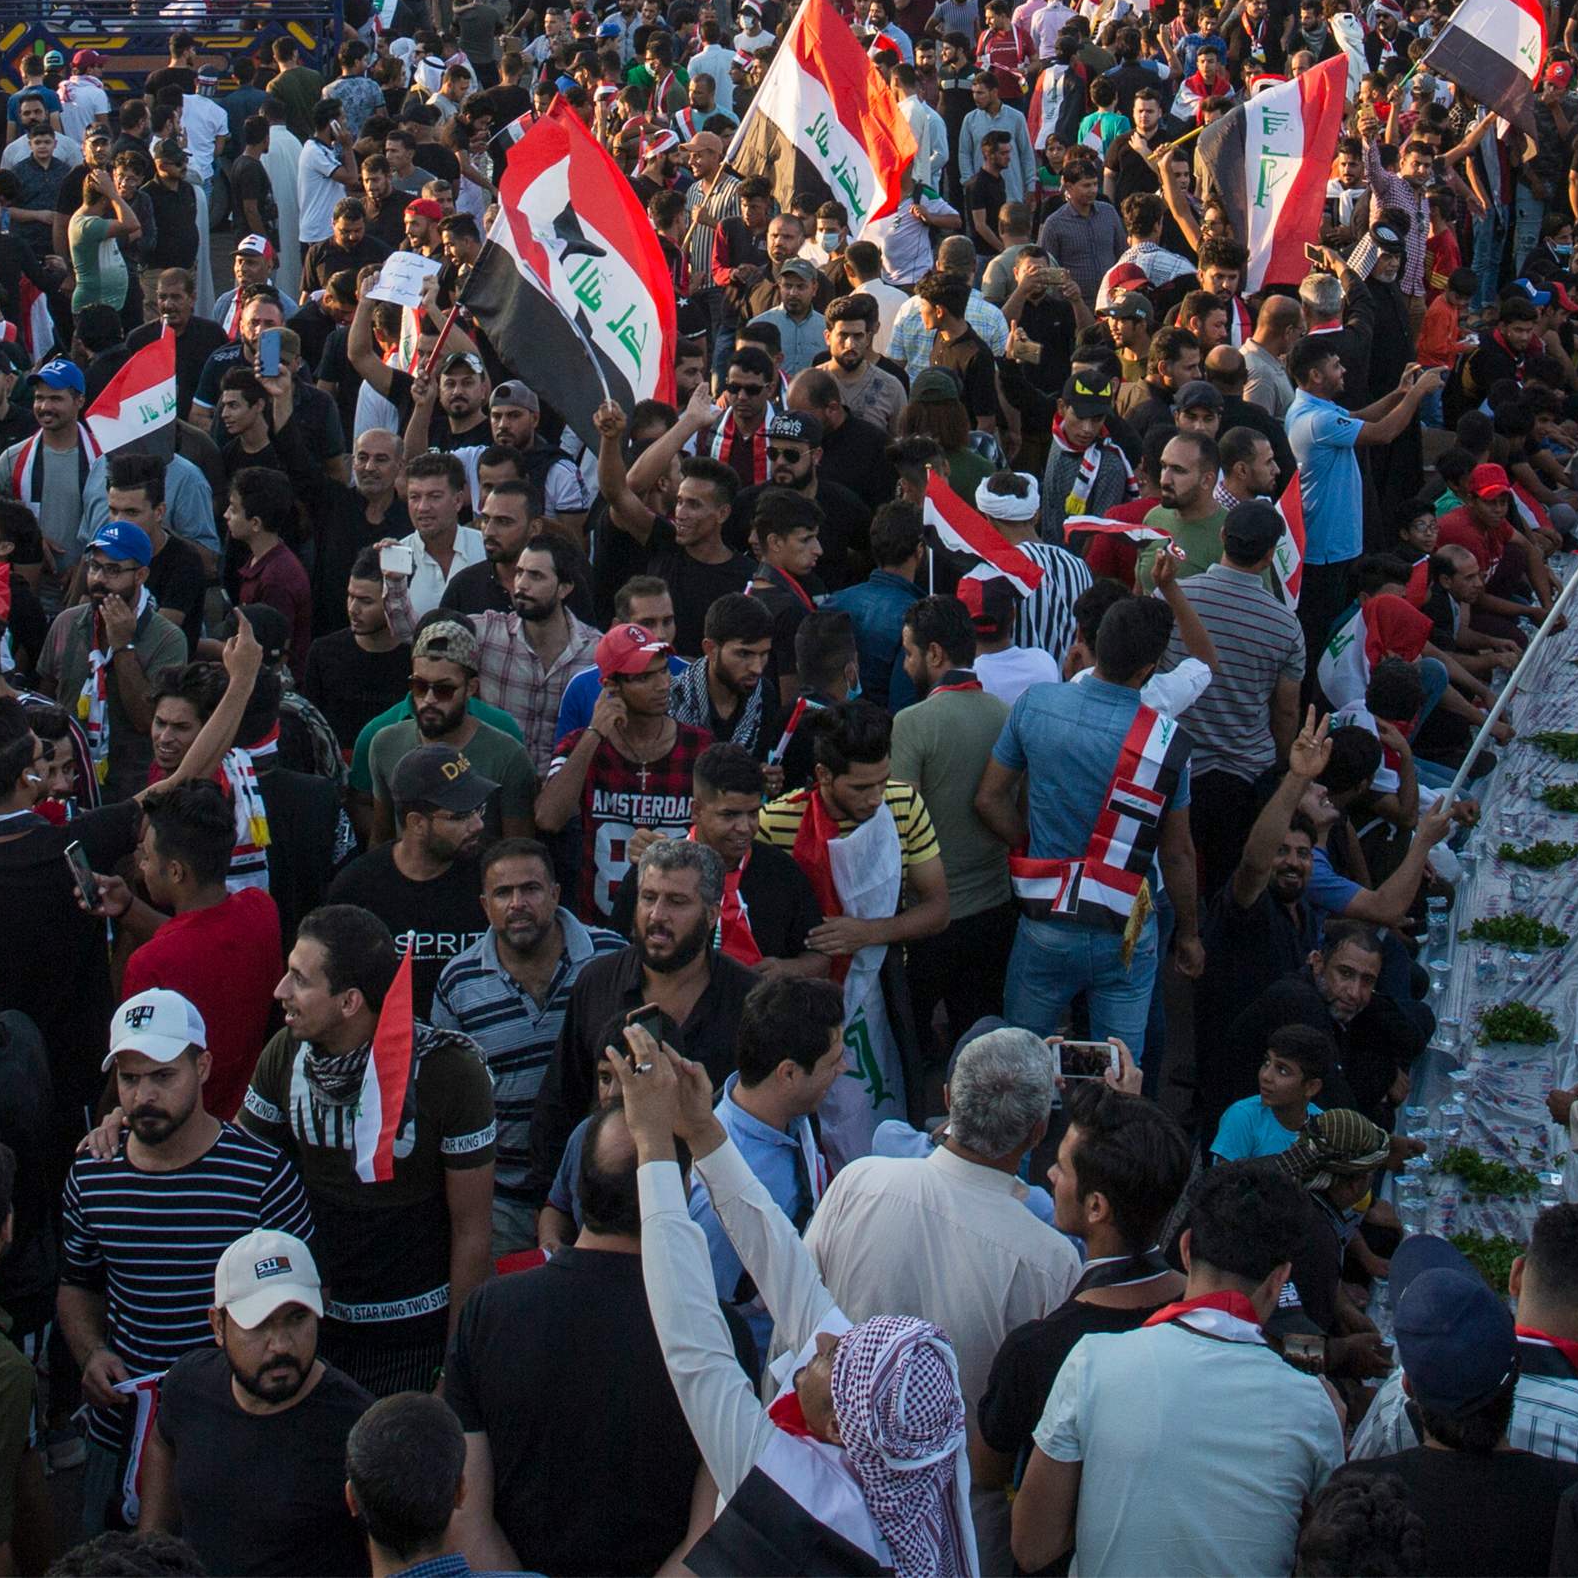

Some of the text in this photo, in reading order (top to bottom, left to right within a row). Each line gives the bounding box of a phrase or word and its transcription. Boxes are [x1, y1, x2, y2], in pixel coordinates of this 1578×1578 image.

[592, 789, 695, 819] AMSTERDA
[458, 1137, 479, 1151] KING
[354, 1305, 380, 1321] STAR
[381, 1304, 406, 1320] KING
[406, 1297, 429, 1315] TWO
